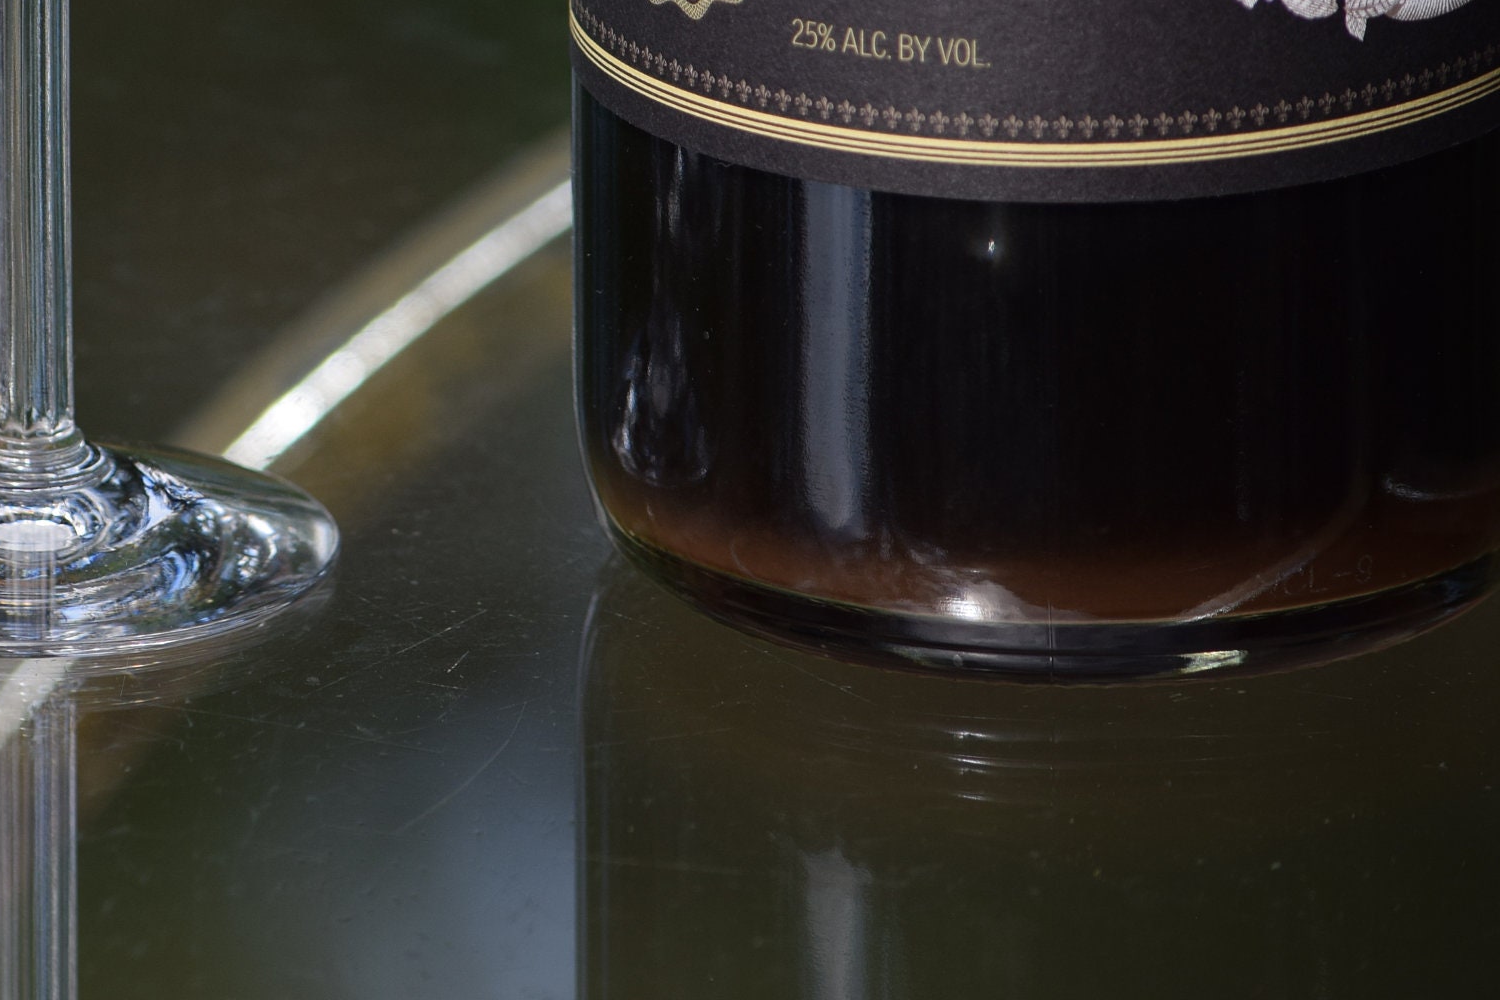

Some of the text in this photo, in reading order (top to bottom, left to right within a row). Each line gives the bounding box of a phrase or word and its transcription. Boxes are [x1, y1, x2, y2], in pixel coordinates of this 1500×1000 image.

[791, 18, 992, 68] 25% ALC. BY VOL.
